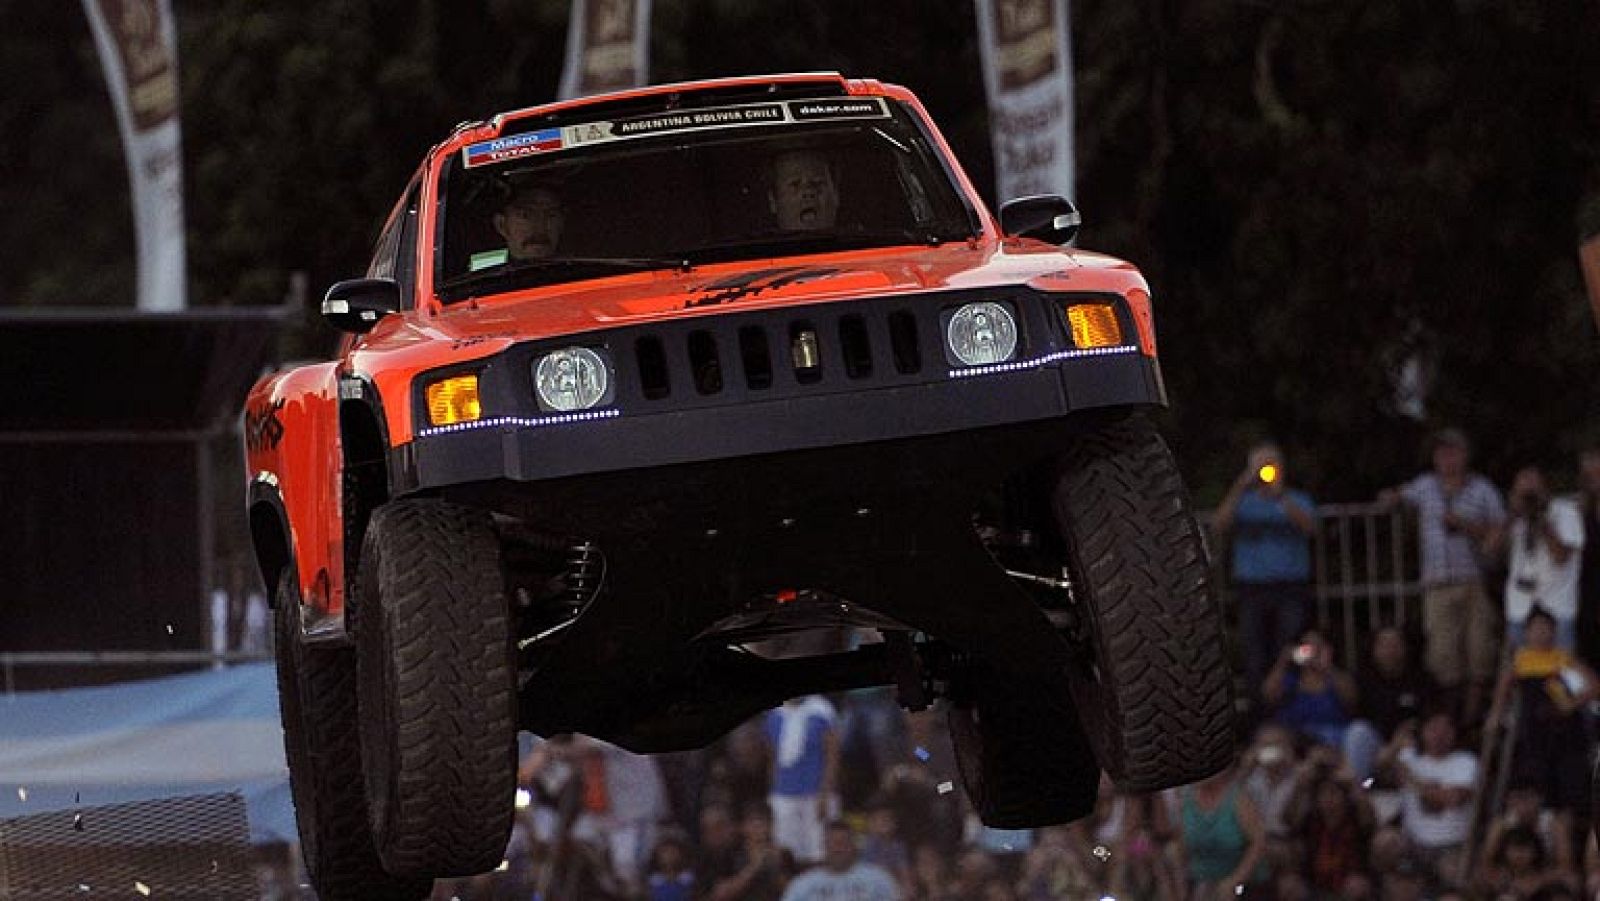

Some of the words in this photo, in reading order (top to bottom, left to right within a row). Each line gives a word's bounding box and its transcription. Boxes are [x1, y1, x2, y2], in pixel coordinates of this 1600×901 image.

[799, 104, 872, 115] dakar.com
[622, 115, 692, 132] ARGENTINA
[695, 111, 743, 123] BOLIVIA
[745, 107, 779, 119] CHILE
